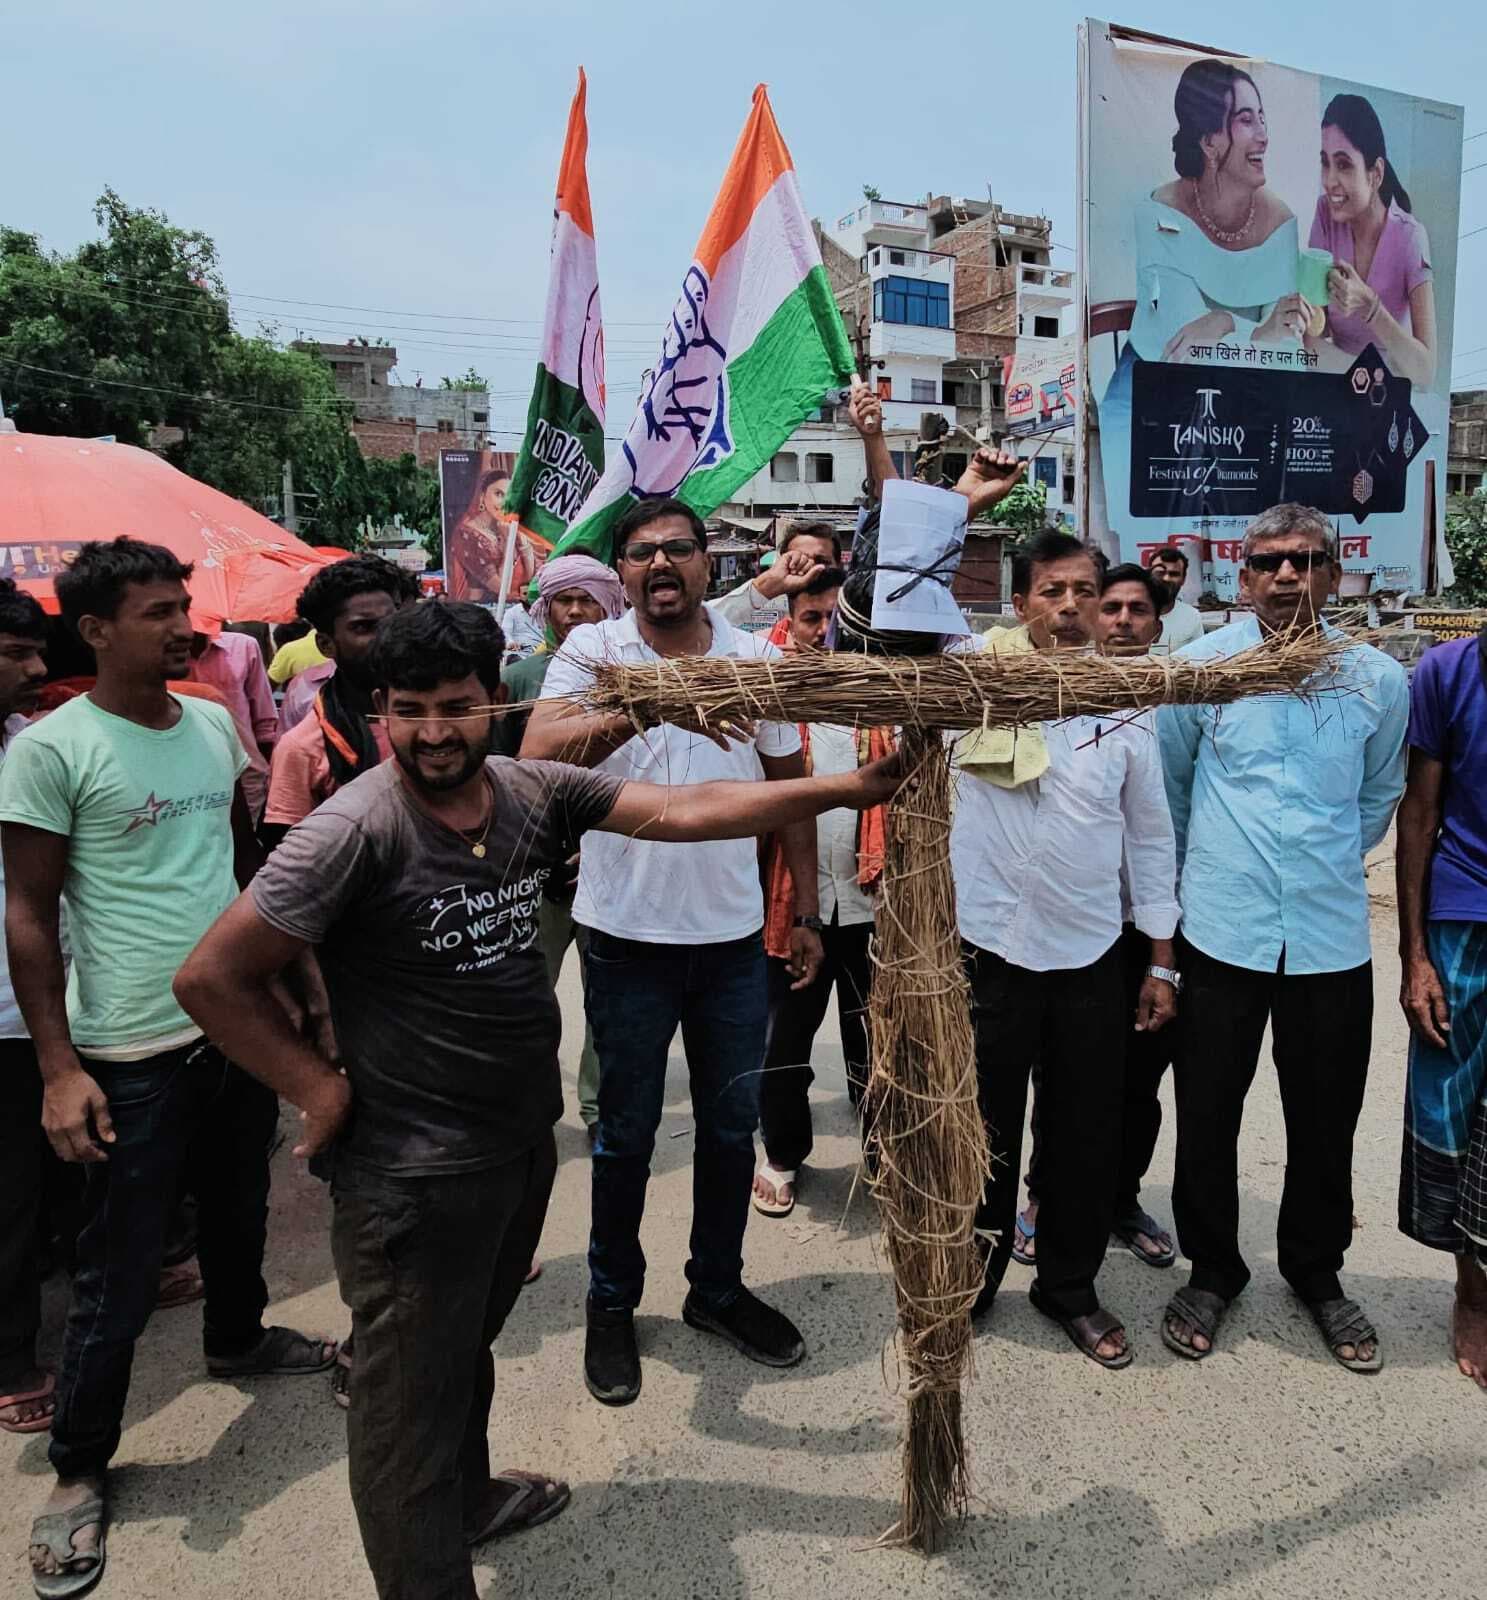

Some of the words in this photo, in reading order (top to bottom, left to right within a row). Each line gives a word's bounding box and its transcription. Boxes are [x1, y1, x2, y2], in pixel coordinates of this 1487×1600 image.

[1189, 344, 1212, 360] आप
[1215, 343, 1240, 361] खिले
[1244, 344, 1257, 361] तो
[1259, 349, 1273, 365] हर
[1276, 351, 1292, 364] पल
[1296, 348, 1319, 367] खिले
[1149, 465, 1190, 480] Festival
[1183, 457, 1219, 496] of
[466, 891, 496, 917] NO
[421, 931, 463, 952] NO
[466, 890, 544, 940] WEEKEN
